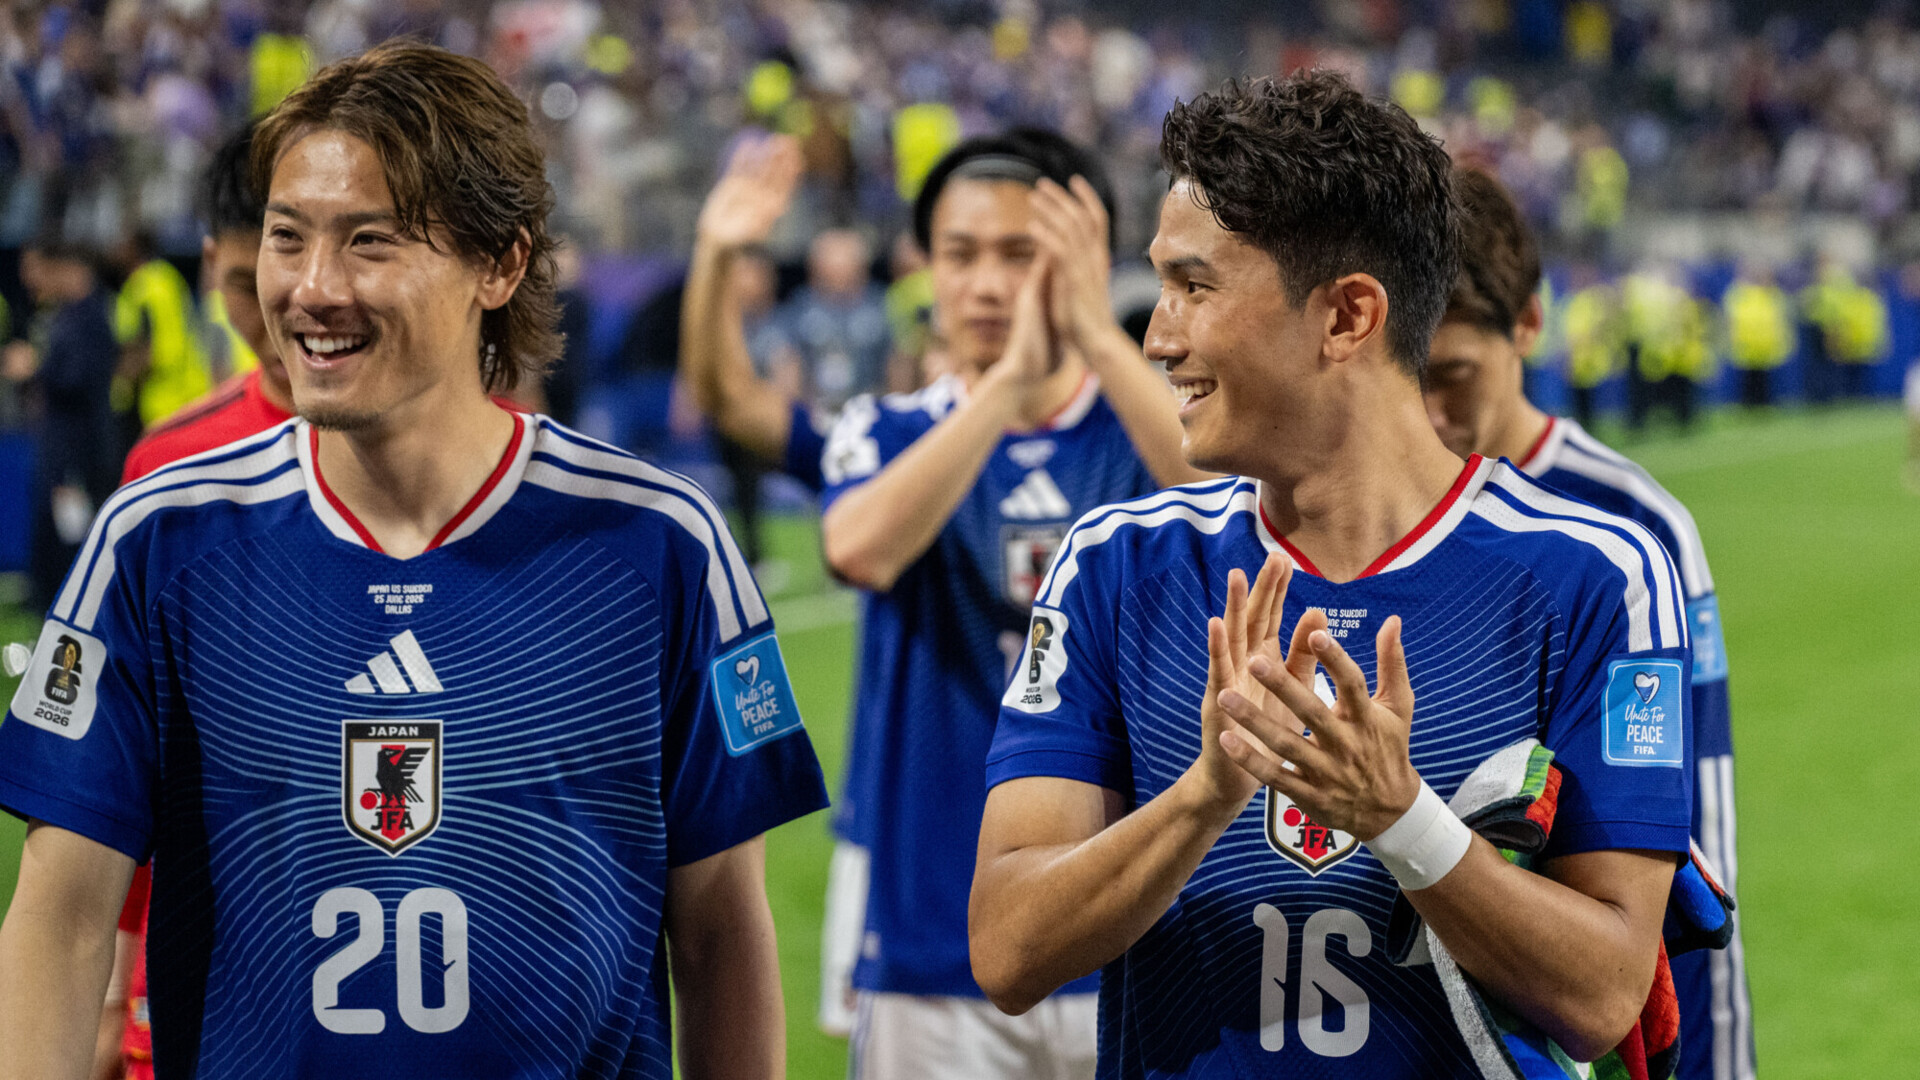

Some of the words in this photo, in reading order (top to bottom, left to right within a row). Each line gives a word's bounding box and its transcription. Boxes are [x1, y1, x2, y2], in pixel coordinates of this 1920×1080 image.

[368, 584, 390, 594] JAPAN
[402, 584, 433, 594] SWEDEN
[374, 594, 385, 604] 25
[386, 594, 404, 604] JUNE
[405, 594, 425, 604] 2026
[385, 604, 413, 615] DALLAS
[1339, 608, 1368, 618] SWEDEN
[1341, 619, 1361, 629] 2026
[1327, 627, 1348, 638] ALLAS
[51, 686, 68, 699] FIFA
[735, 688, 761, 711] Unite
[758, 680, 776, 700] For
[38, 700, 60, 713] WORLD
[59, 707, 73, 716] CUP
[741, 698, 780, 728] PEACE
[1625, 703, 1650, 724] Unite
[1650, 706, 1666, 724] For
[33, 707, 70, 727] 2026
[368, 726, 419, 737] JAPAN
[753, 720, 776, 736] FIFA
[1627, 724, 1664, 744] PEACE
[1634, 745, 1655, 755] FIFA
[370, 811, 415, 831] JFA
[1292, 828, 1338, 850] JFA
[312, 887, 470, 1034] 20
[1253, 903, 1372, 1057] 16
